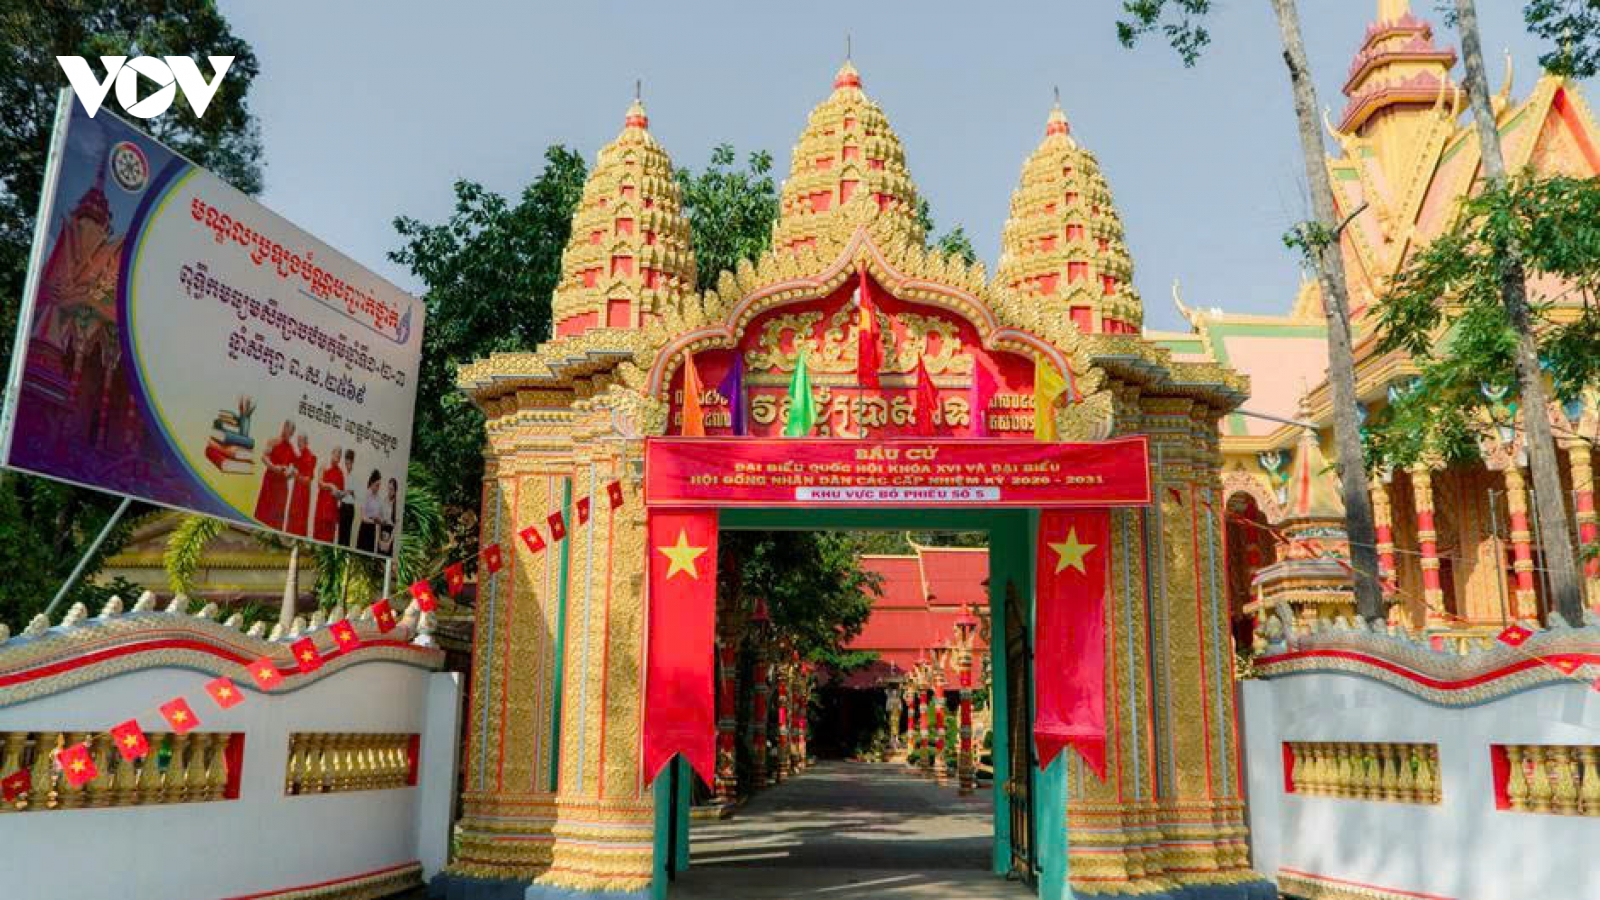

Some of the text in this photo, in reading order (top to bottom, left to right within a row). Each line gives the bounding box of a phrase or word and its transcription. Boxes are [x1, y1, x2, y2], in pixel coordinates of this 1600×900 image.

[855, 445, 939, 461] BẦU CỬ
[734, 462, 762, 473] ĐẠI
[766, 460, 804, 472] BIỂU
[809, 461, 851, 473] QUỐC
[856, 462, 883, 474] HỘI
[937, 464, 961, 473] XVI
[966, 462, 986, 473] VÀ
[992, 463, 1018, 474] ĐẠI
[1023, 459, 1060, 472] BIỂU
[690, 474, 718, 485] HỘI
[723, 472, 766, 485] ĐỒNG
[771, 475, 813, 485] NHÂN
[819, 474, 852, 485] DÂN
[856, 475, 888, 485] CÁC
[893, 474, 924, 485] CẤP
[929, 475, 980, 485] NHIỆM
[984, 475, 1005, 485] KỲ
[1065, 475, 1103, 484] 2031
[811, 487, 984, 499] KHU VỰC BỎ PHIẾU SỐ 5
